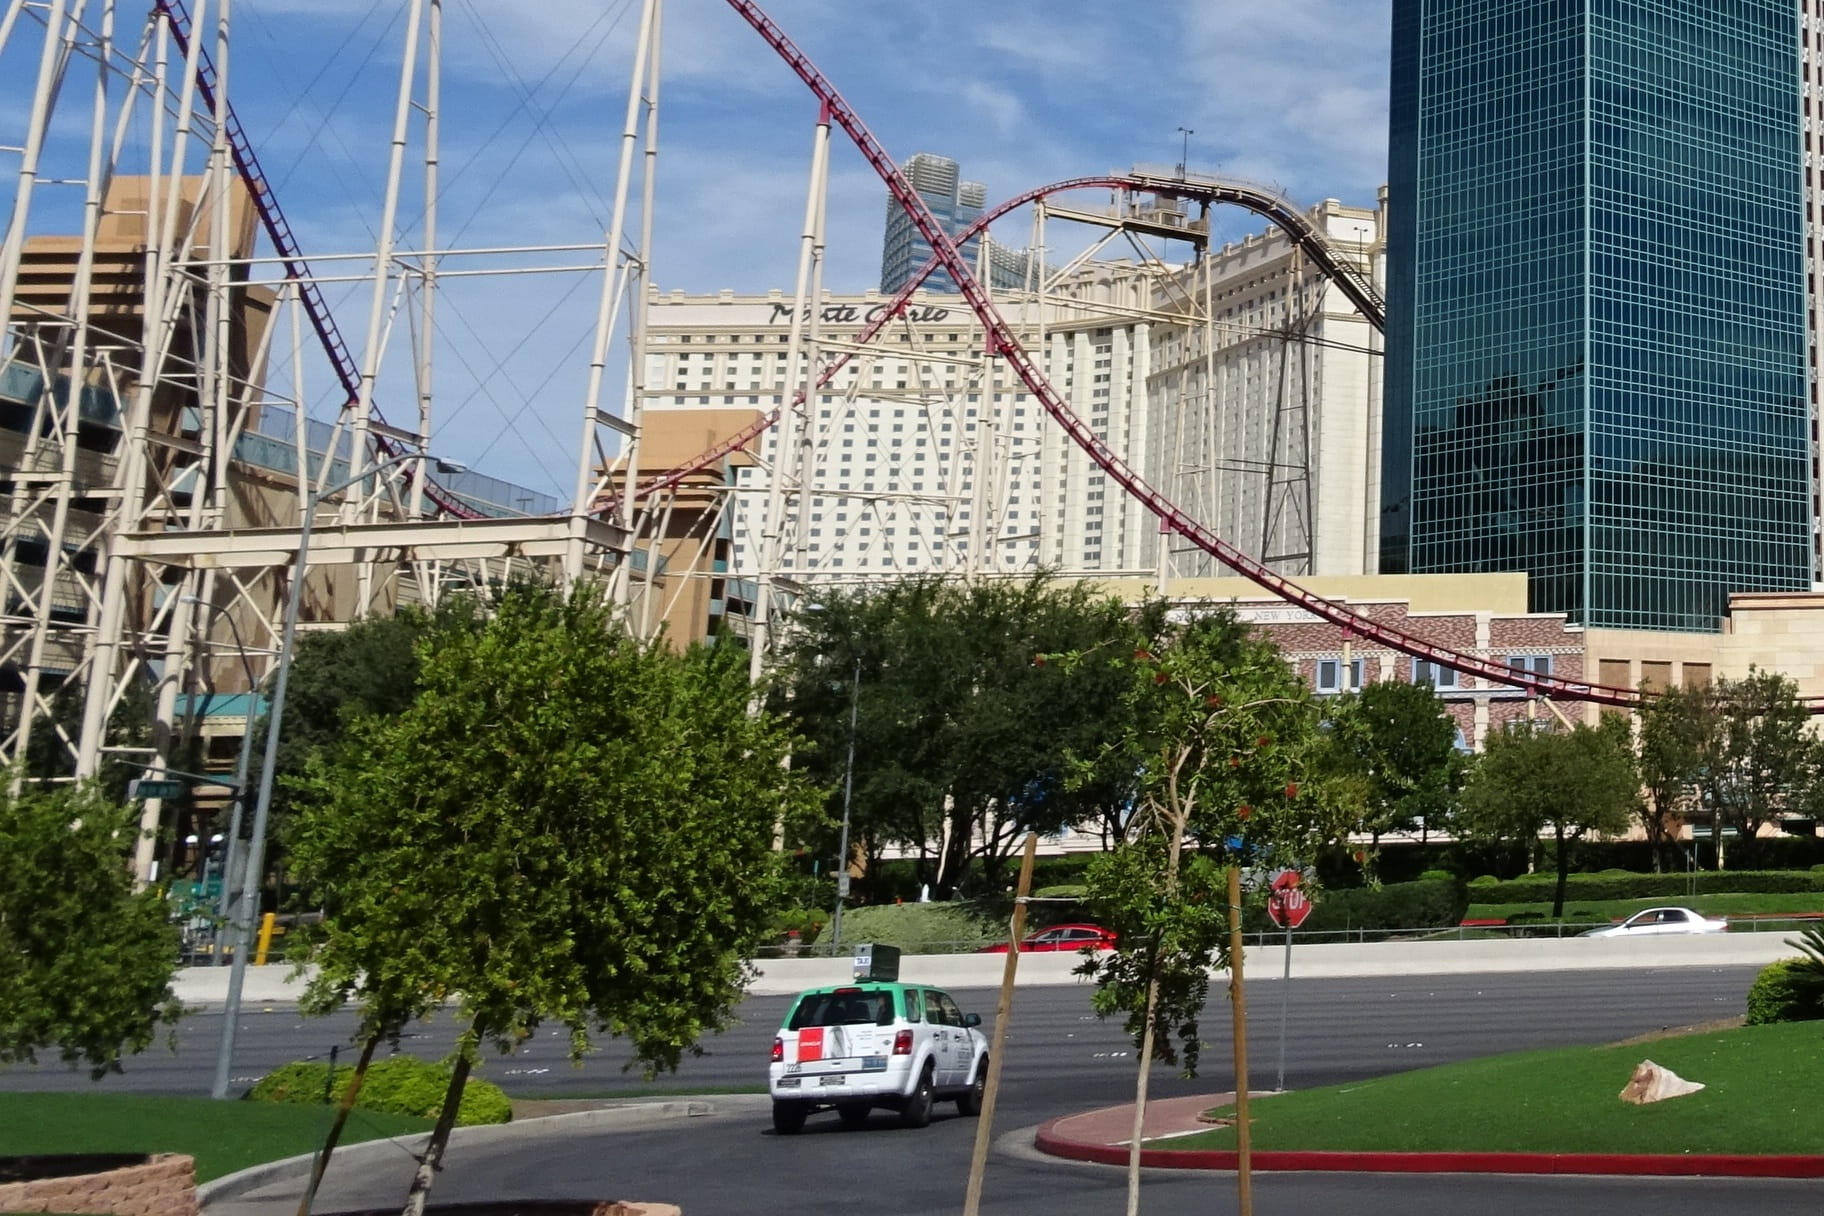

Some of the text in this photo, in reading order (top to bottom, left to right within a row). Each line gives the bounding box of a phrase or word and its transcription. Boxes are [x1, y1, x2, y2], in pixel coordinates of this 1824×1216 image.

[865, 304, 949, 324] Crlo
[1254, 609, 1319, 622] NEW YORK
